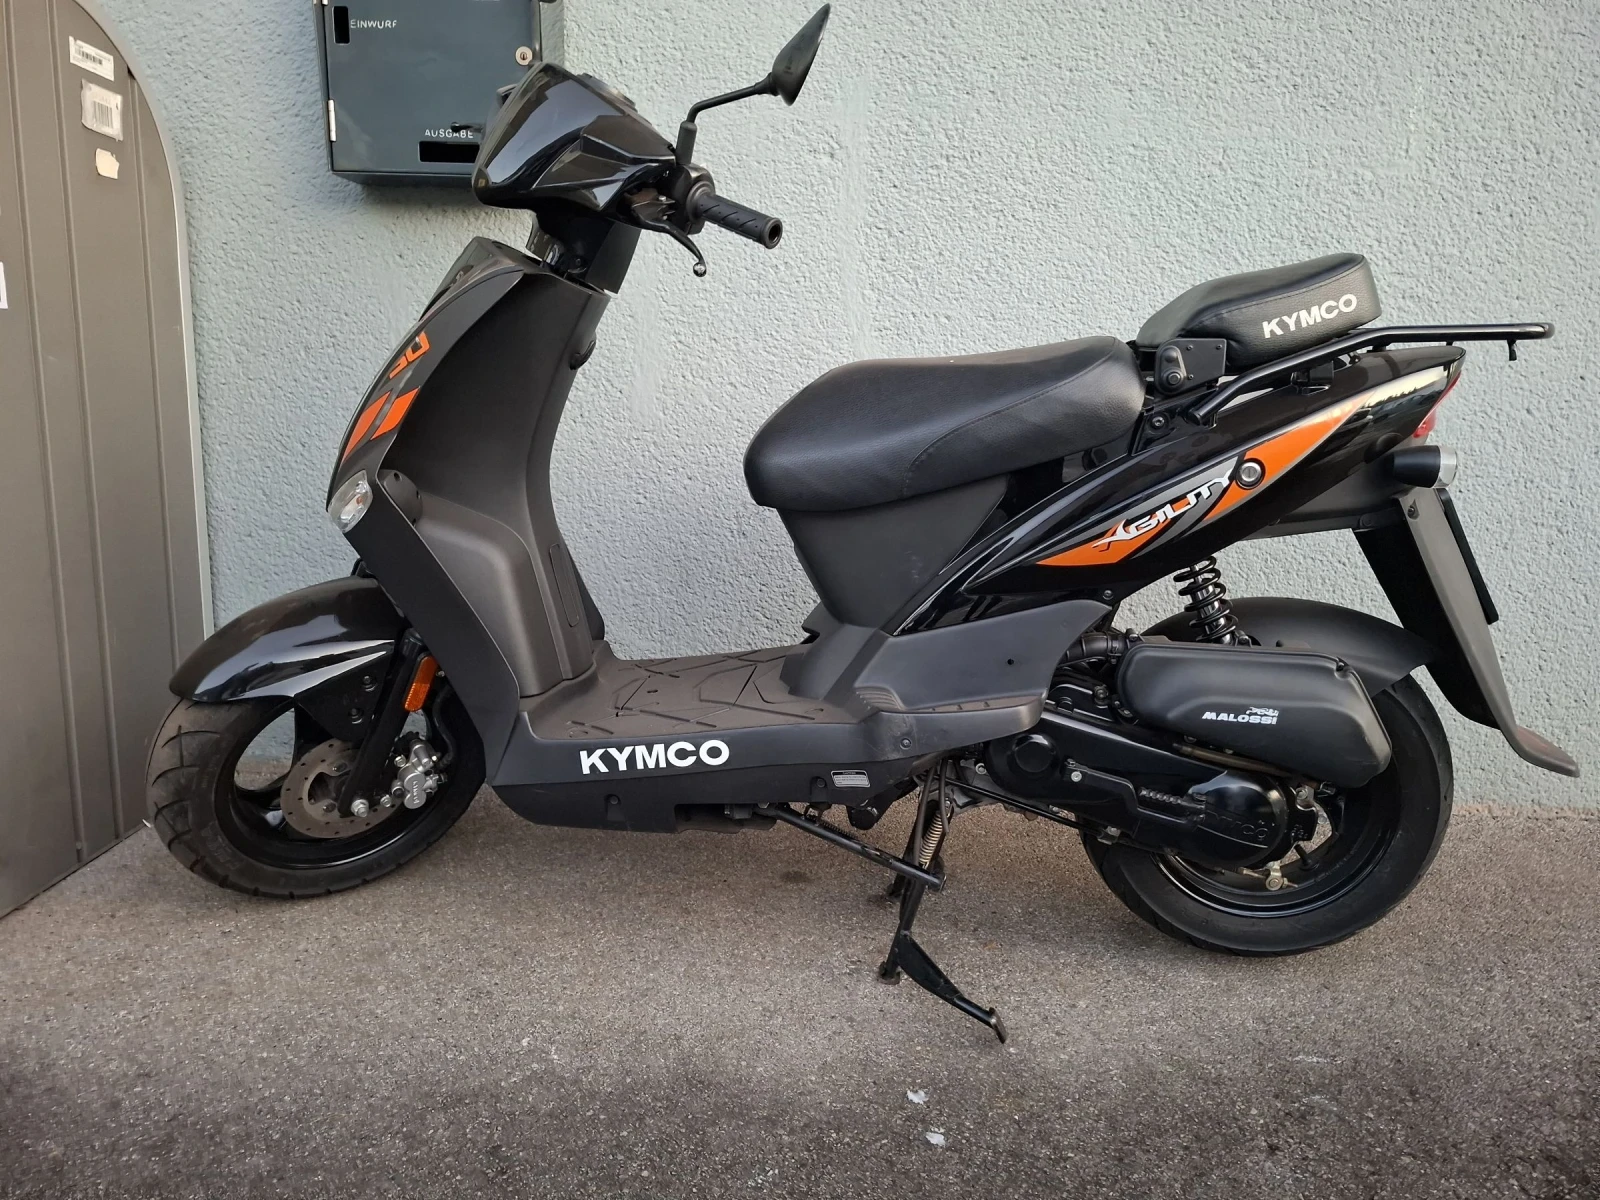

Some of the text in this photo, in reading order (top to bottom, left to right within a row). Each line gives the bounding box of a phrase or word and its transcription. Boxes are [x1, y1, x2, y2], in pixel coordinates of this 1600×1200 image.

[350, 19, 397, 29] EINWURF
[1262, 293, 1358, 339] KYMCO
[1202, 711, 1278, 725] MALOSSI
[579, 739, 730, 775] KYMCO
